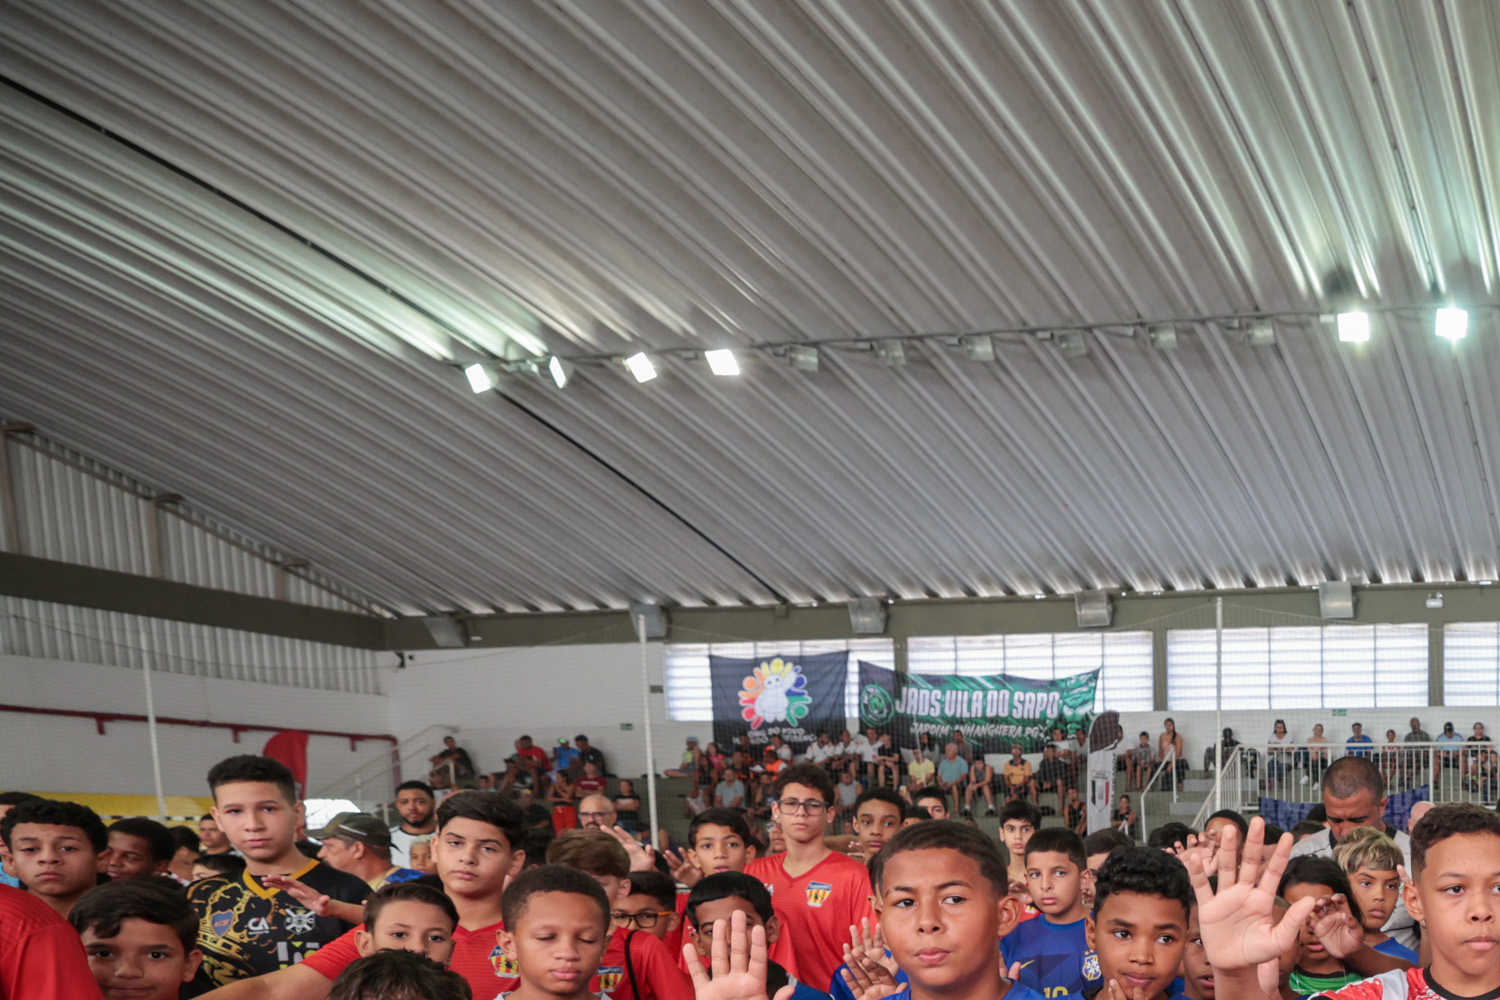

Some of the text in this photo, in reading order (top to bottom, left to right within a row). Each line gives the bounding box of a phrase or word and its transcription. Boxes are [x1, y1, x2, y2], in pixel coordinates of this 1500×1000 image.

[895, 687, 941, 717] JADS
[944, 690, 983, 718] VILA
[986, 689, 1010, 716] DO
[1012, 691, 1060, 719] SAPO
[910, 722, 950, 737] JARDIM
